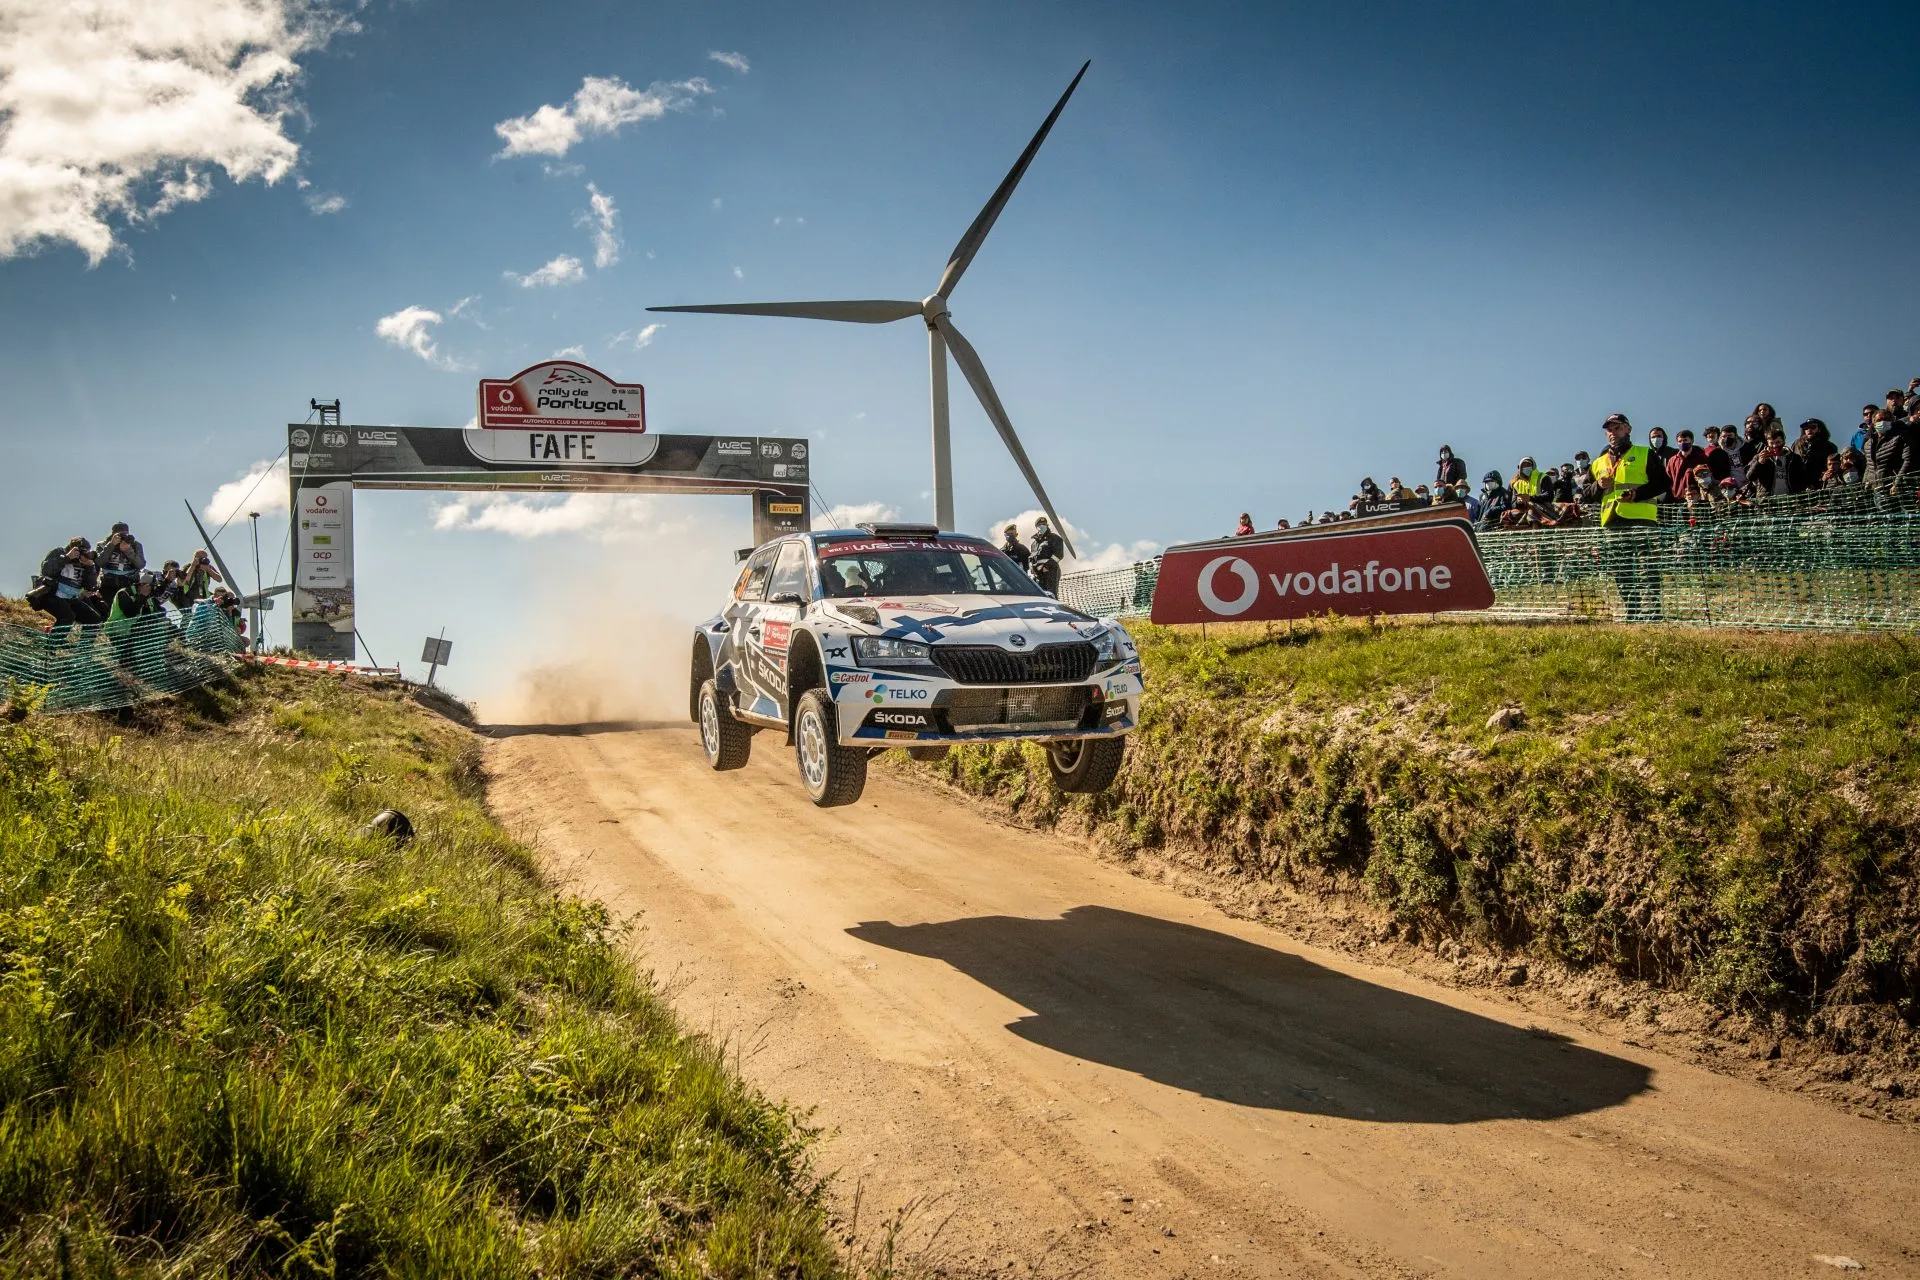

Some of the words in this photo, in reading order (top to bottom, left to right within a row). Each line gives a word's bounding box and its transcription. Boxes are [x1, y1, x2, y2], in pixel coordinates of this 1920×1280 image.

[538, 388, 570, 398] rally
[572, 388, 589, 396] de
[536, 397, 627, 413] Portugal
[357, 431, 398, 440] WRC
[530, 433, 596, 460] FAFE
[717, 440, 752, 450] WRC
[1365, 502, 1401, 512] WRC
[922, 541, 948, 550] ALL
[948, 543, 978, 553] LIVE
[313, 551, 332, 560] acp
[1269, 560, 1452, 597] vodafone
[758, 657, 789, 700] ŠKODA
[840, 673, 870, 683] Castrol
[1113, 683, 1128, 694] TELKO
[888, 689, 928, 700] TELKO
[1106, 705, 1125, 718] ŠKODA
[874, 711, 927, 725] ŠKODA
